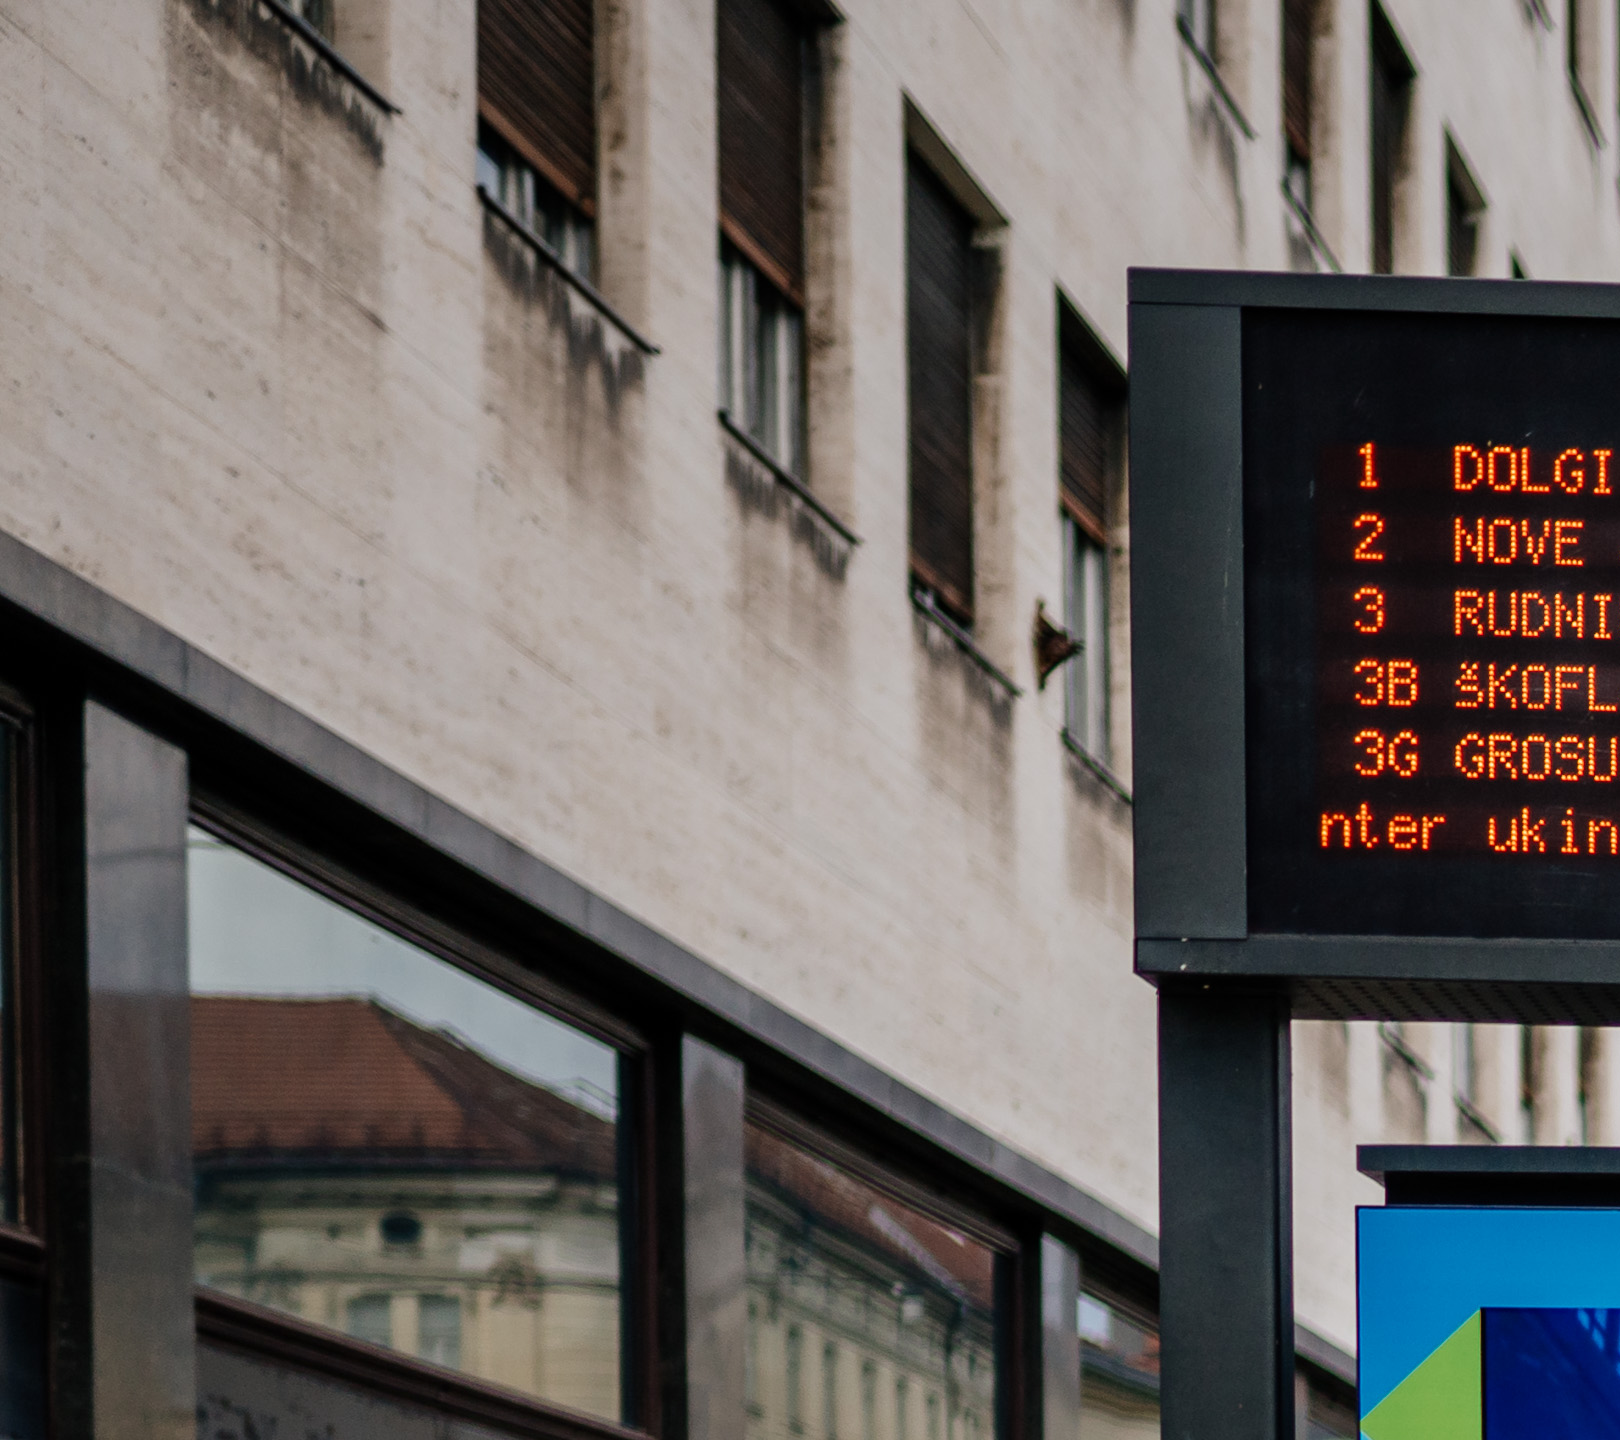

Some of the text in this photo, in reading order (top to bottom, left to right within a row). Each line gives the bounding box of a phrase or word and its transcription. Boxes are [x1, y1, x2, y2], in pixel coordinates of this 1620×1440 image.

[1357, 441, 1380, 490] 1
[1453, 441, 1613, 495] DOLGI
[1353, 513, 1385, 562] 2
[1453, 516, 1585, 567] NOVE
[1353, 585, 1386, 634] 3
[1353, 658, 1420, 708] 3B
[1353, 728, 1420, 778] 3G
[1320, 801, 1447, 851] nter
